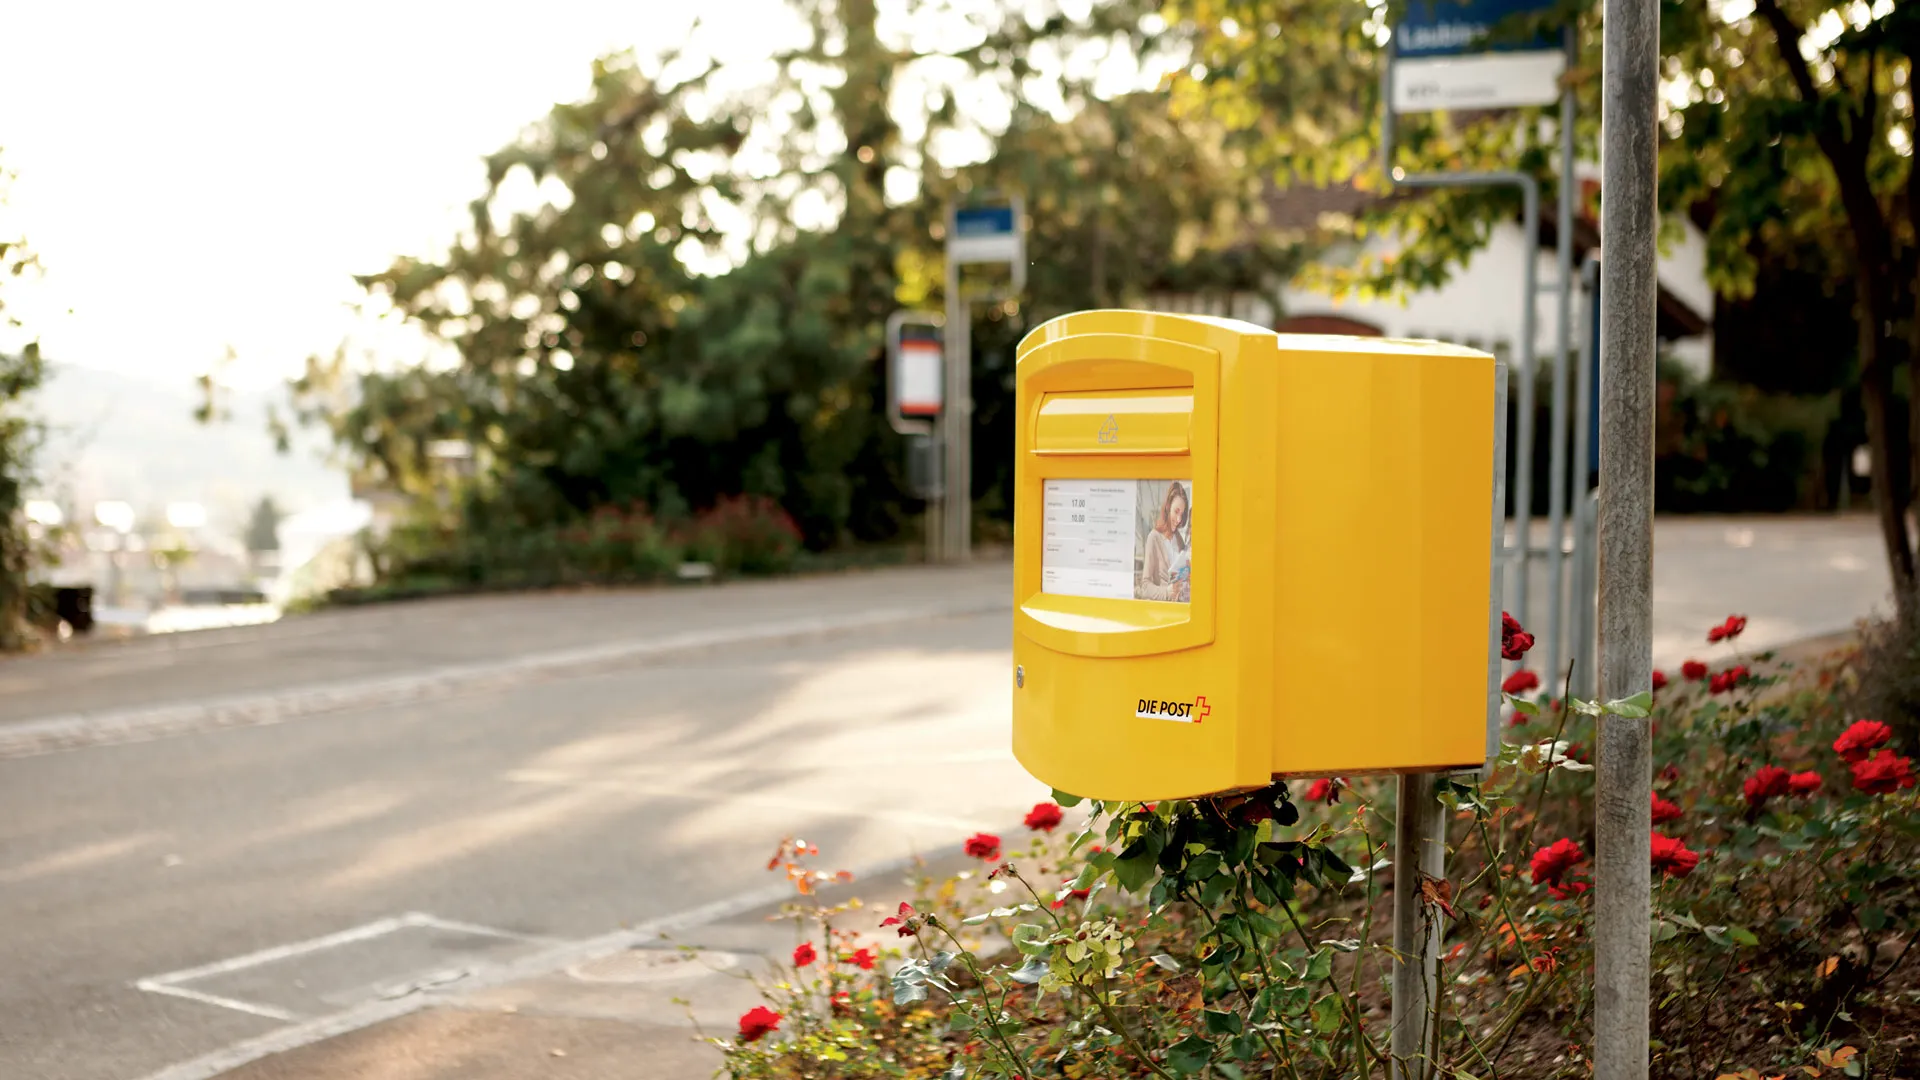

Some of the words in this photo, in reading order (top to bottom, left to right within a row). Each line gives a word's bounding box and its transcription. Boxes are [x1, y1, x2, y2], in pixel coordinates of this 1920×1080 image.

[1071, 499, 1086, 508] 17.00
[1137, 699, 1158, 714] DIE
[1160, 701, 1194, 717] POST
